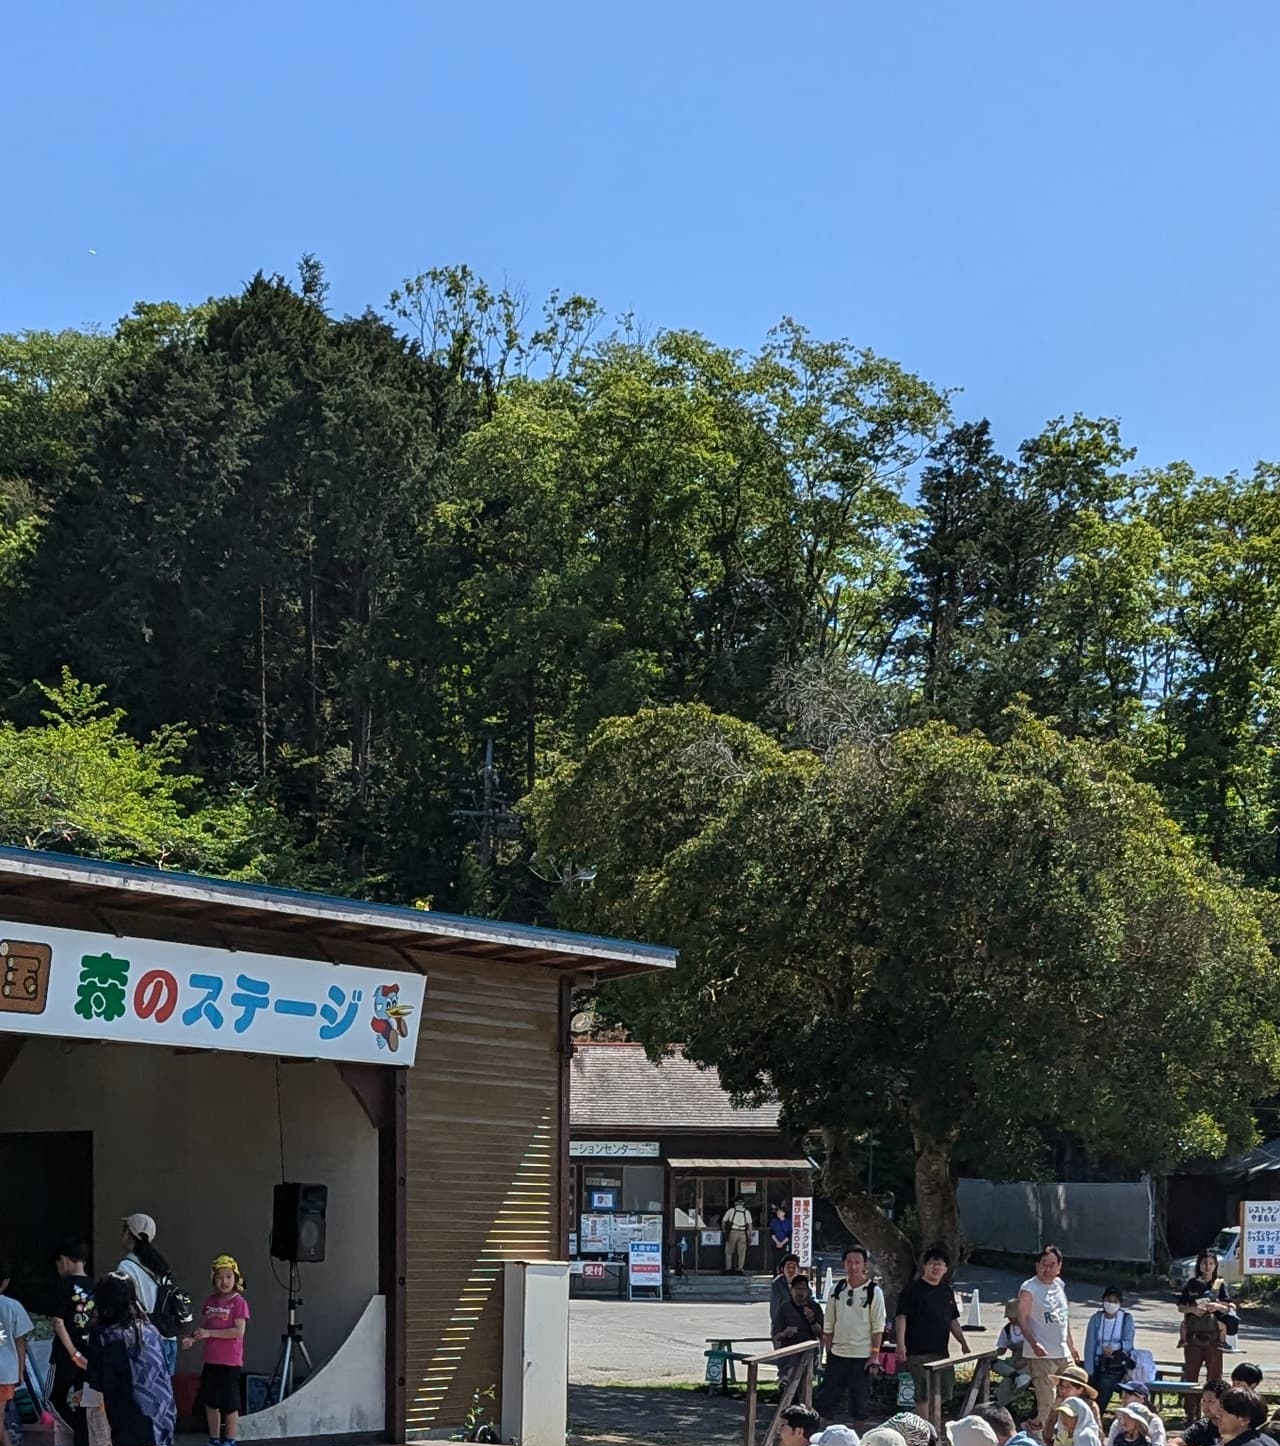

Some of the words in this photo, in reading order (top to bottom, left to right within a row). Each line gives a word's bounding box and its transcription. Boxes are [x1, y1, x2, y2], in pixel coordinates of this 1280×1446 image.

[74, 952, 363, 1040] 森のステージ
[1248, 1206, 1280, 1214] レストラン
[1251, 1214, 1277, 1222] やまもも
[802, 1200, 810, 1263] アトラクション
[584, 1264, 603, 1276] 受付
